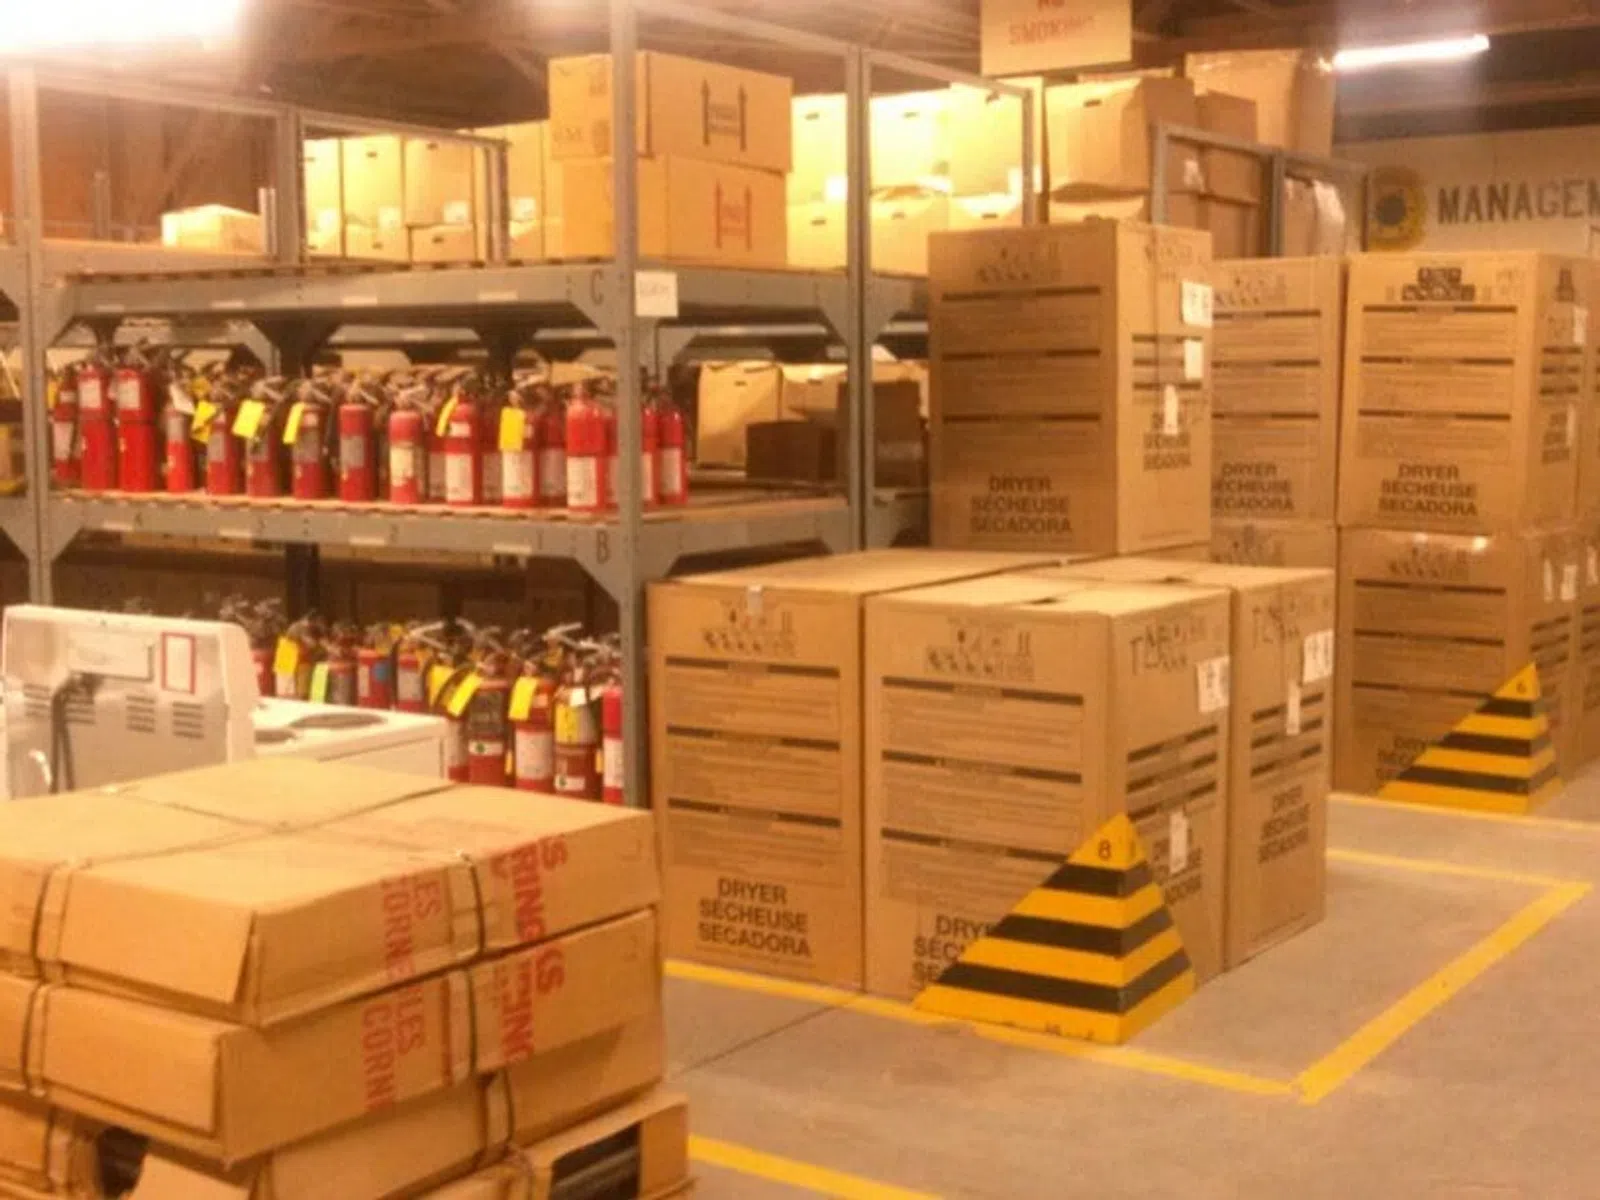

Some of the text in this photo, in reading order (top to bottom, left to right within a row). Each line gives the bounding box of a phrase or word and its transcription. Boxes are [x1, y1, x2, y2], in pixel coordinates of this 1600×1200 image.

[1397, 463, 1460, 480] DRYER
[717, 876, 788, 905] DRYER
[697, 921, 814, 958] SECADORA
[396, 984, 426, 1056] LES
